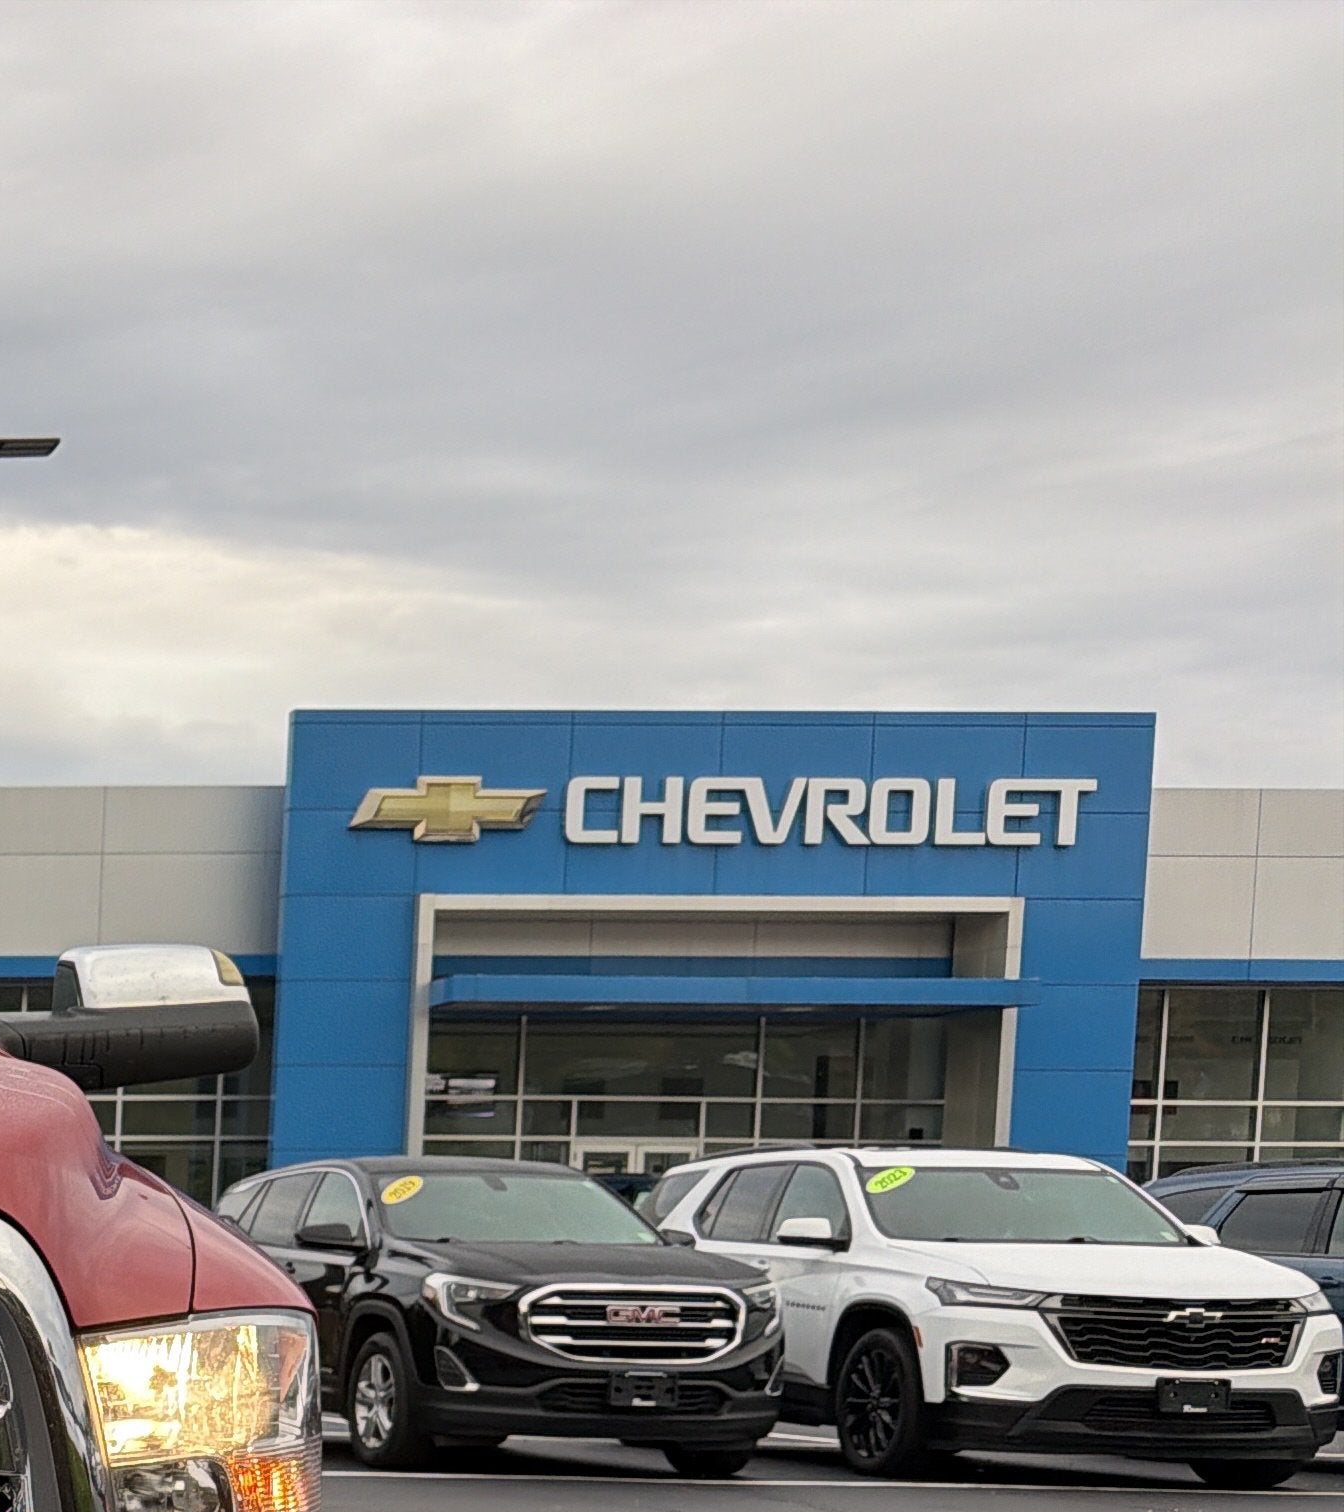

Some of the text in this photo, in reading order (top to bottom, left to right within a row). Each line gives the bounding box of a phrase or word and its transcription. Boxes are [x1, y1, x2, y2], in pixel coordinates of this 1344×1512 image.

[565, 776, 1098, 847] CHEVROLET
[874, 1169, 908, 1189] 2023
[606, 1305, 681, 1324] GMC
